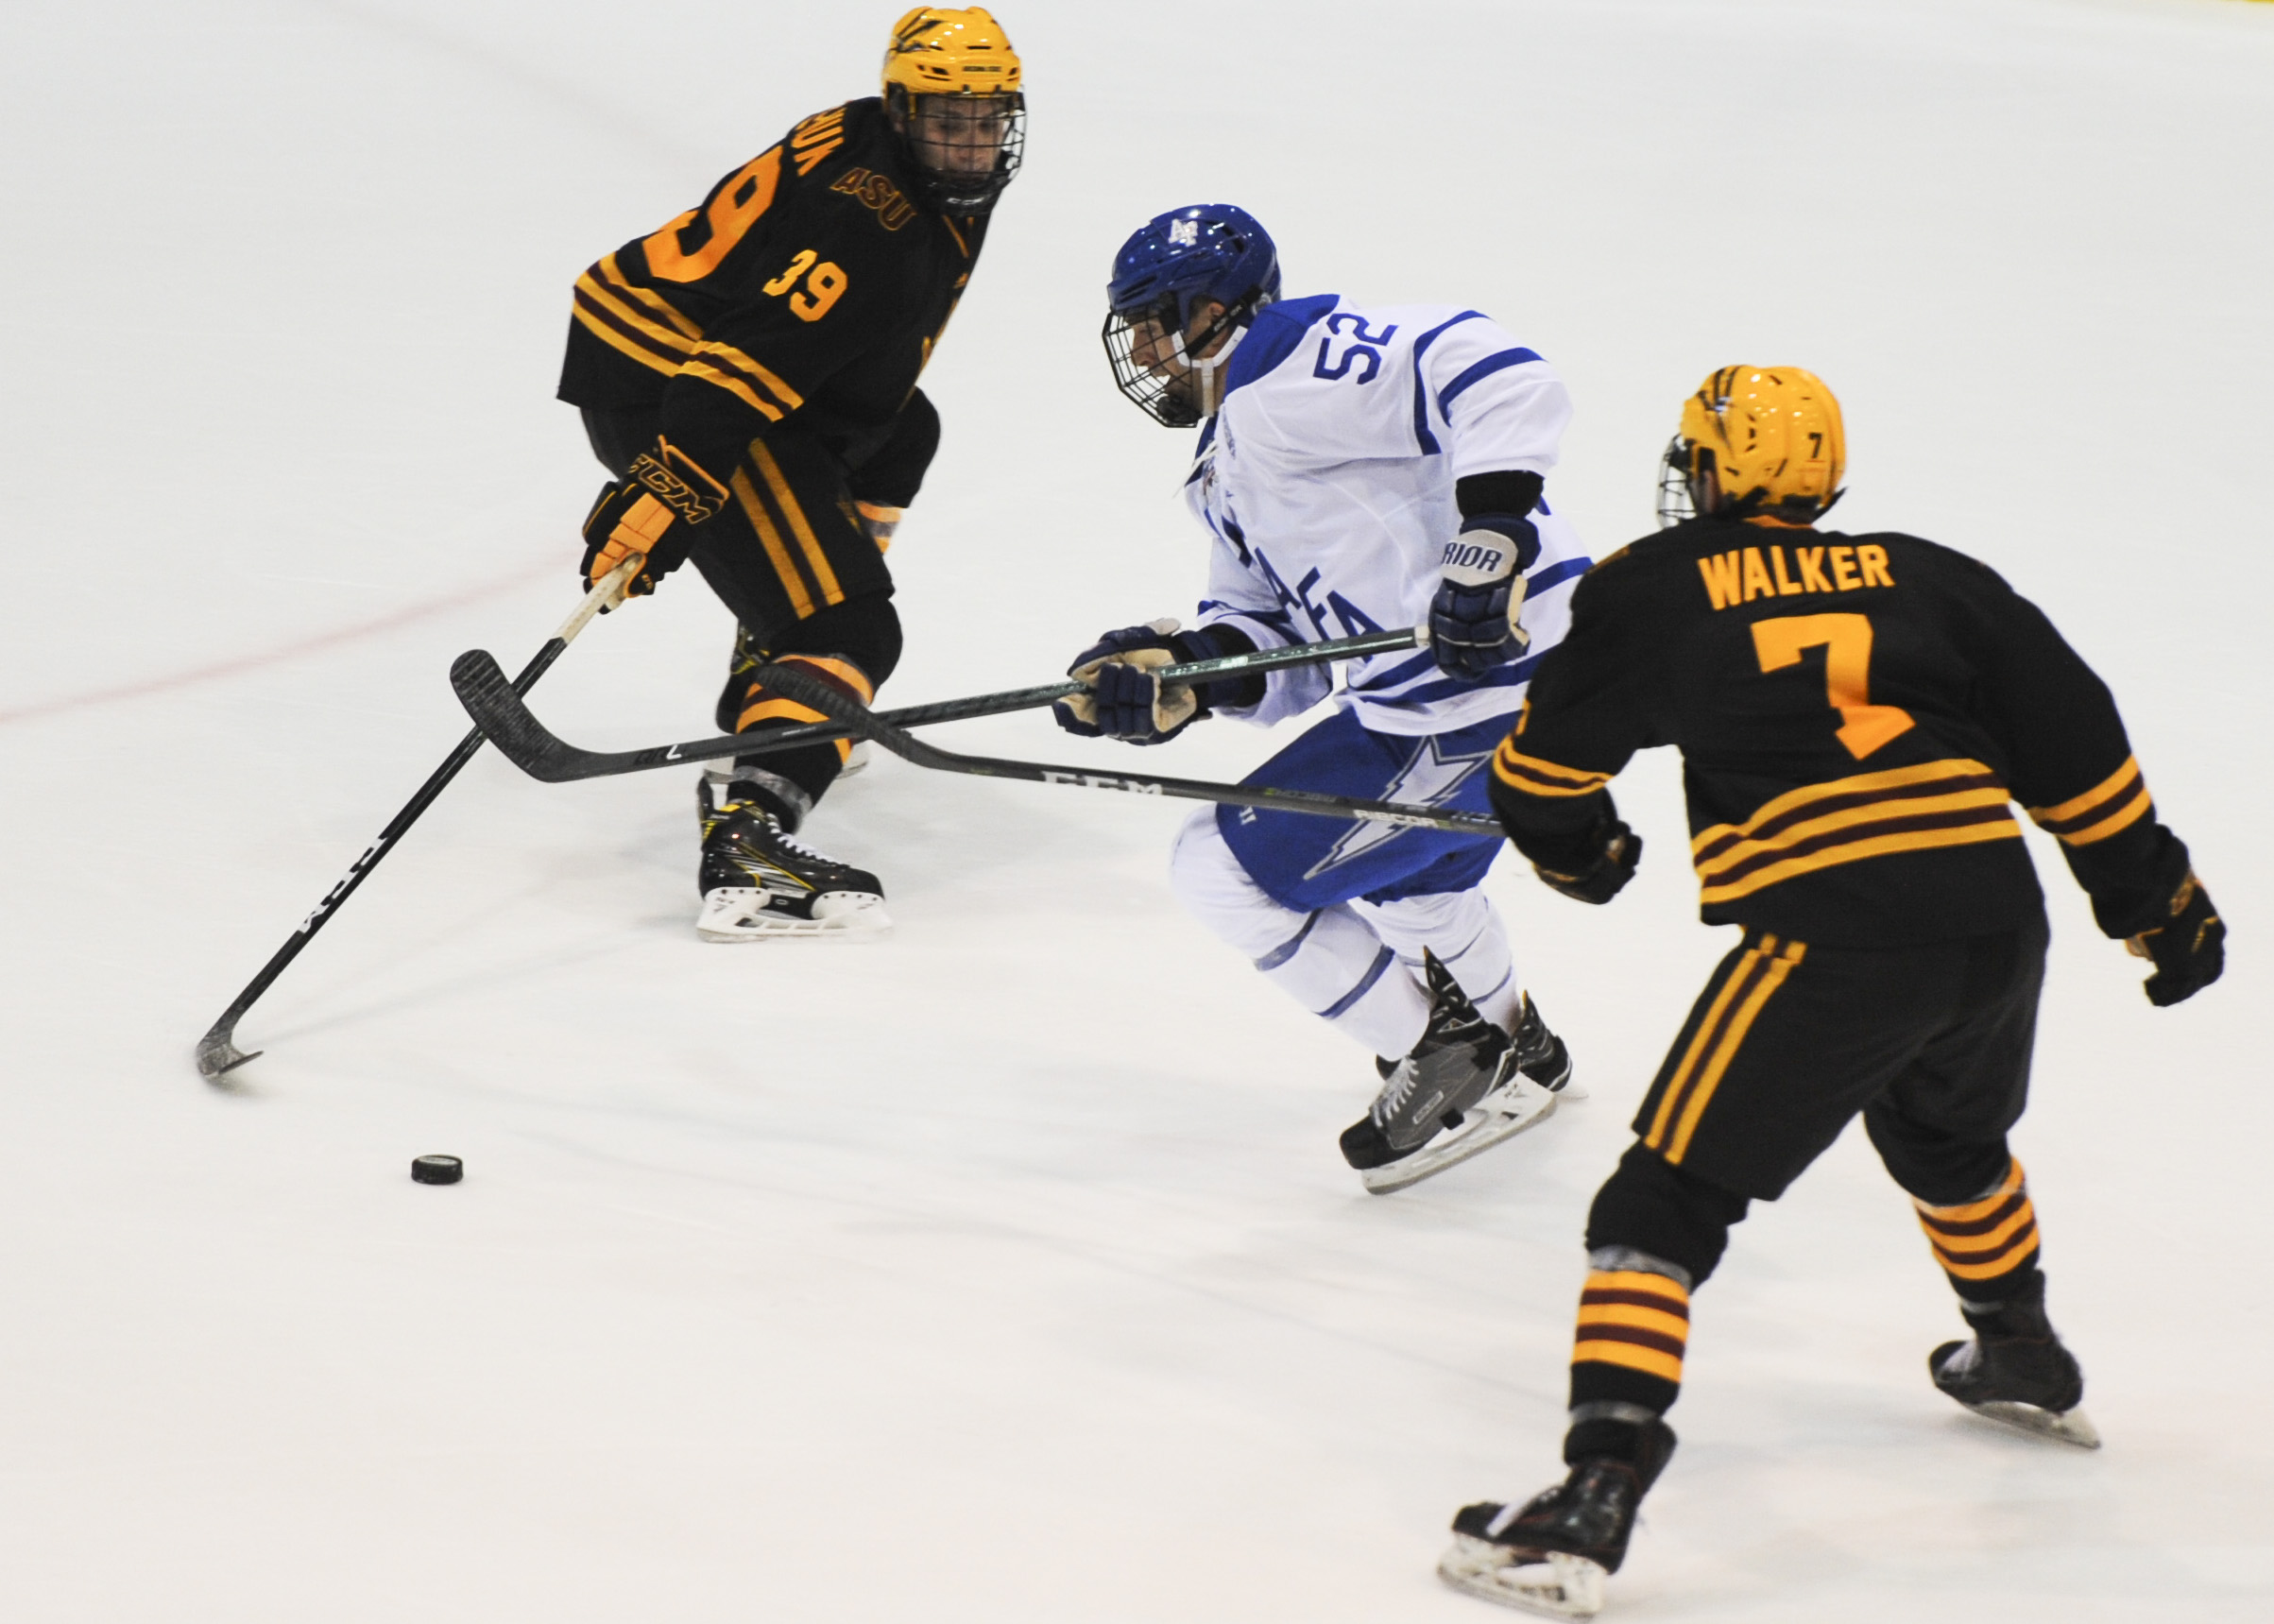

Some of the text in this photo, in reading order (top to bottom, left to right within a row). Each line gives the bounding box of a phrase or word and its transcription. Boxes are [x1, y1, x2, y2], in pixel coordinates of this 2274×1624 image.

[829, 167, 918, 231] ASU
[762, 248, 848, 322] 39
[1313, 313, 1399, 385] 52
[1808, 433, 1823, 459] 7
[1699, 544, 1895, 611] WALKER
[1751, 612, 1915, 761] 7
